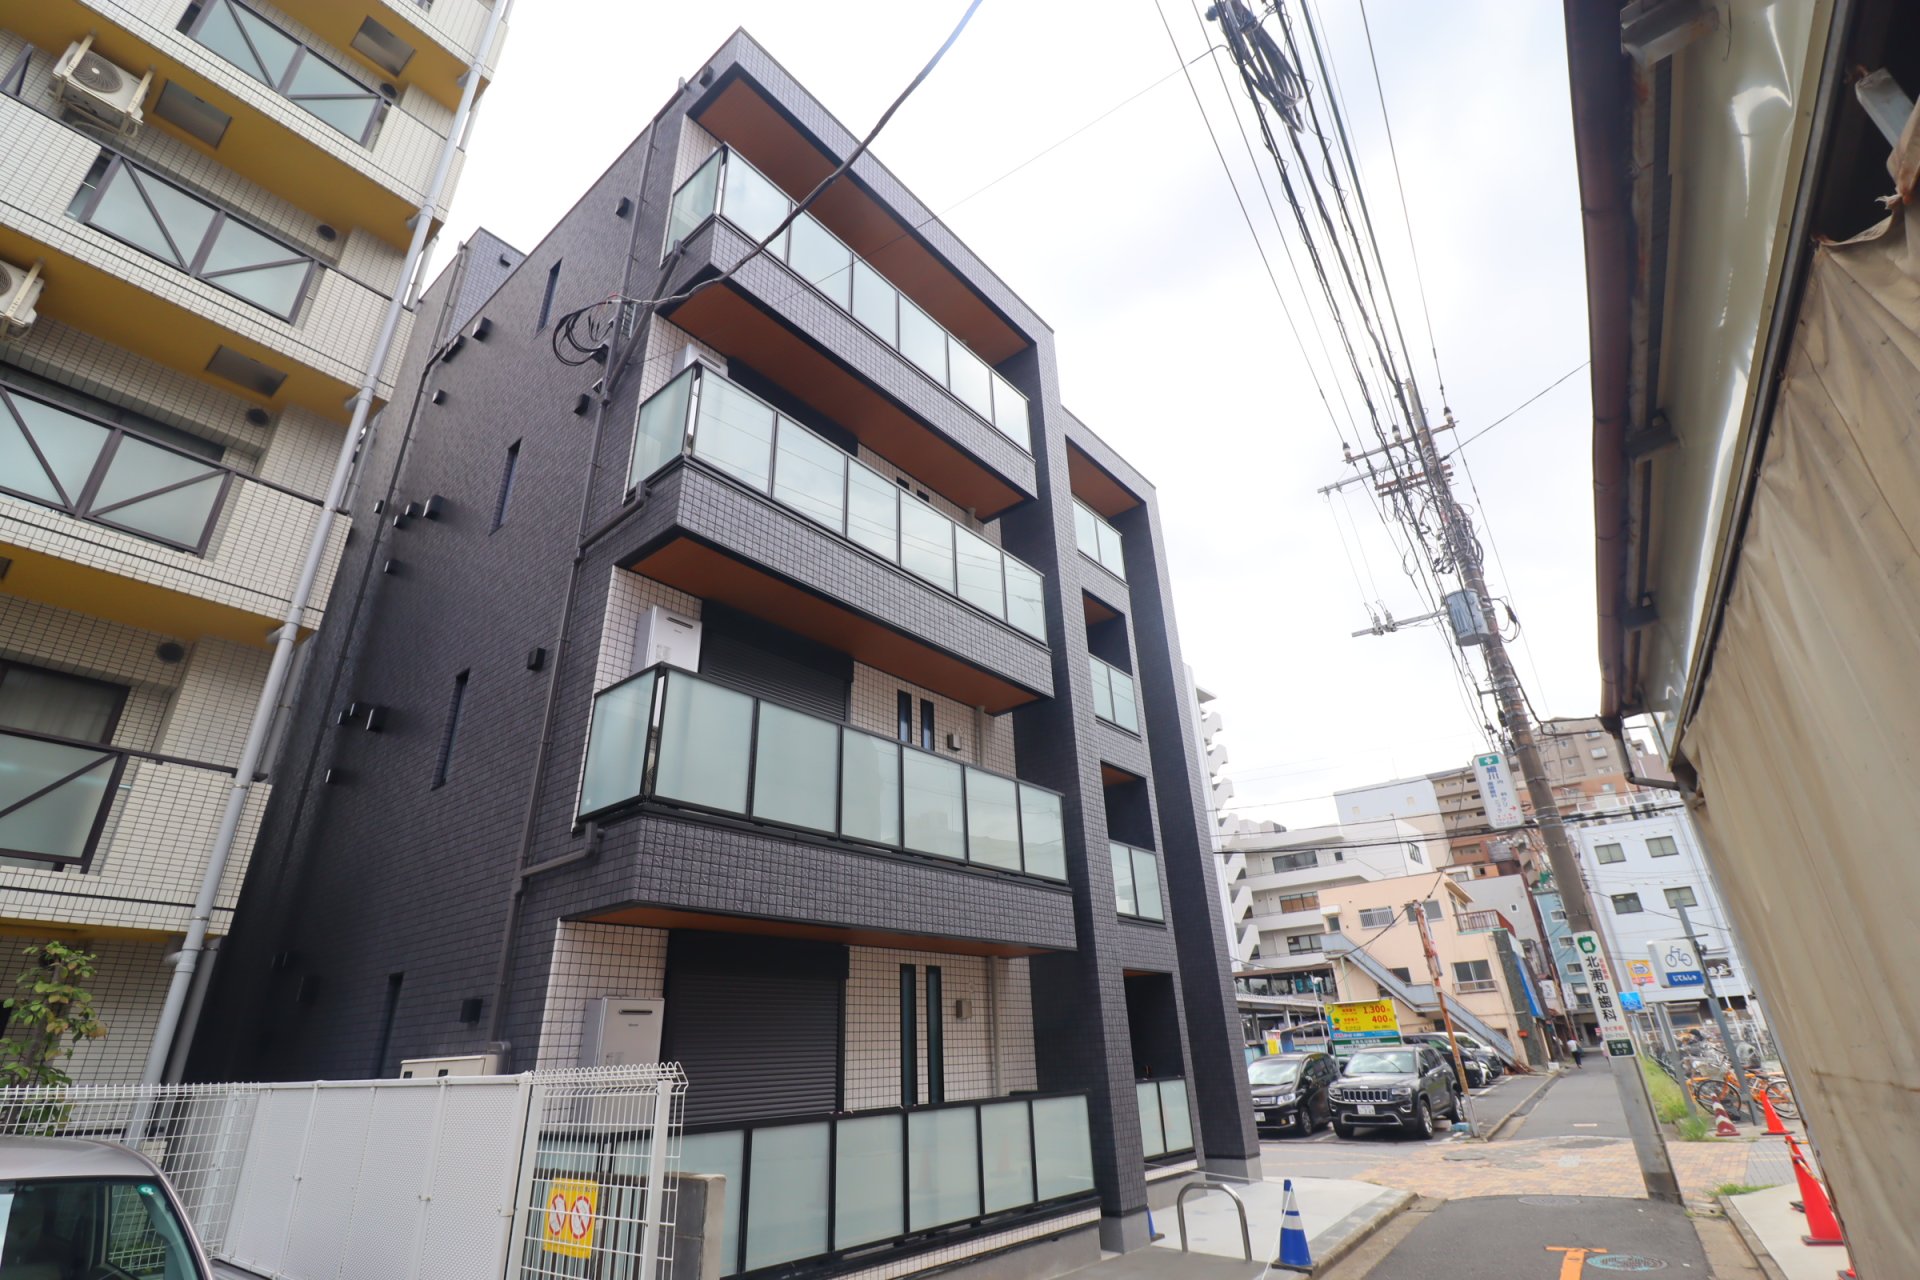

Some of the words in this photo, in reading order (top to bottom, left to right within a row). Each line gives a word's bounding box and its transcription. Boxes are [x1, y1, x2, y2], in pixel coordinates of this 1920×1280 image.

[1585, 956, 1617, 1022] 北浦和歯科
[1363, 1005, 1386, 1014] 1,300
[1372, 1015, 1388, 1023] 400
